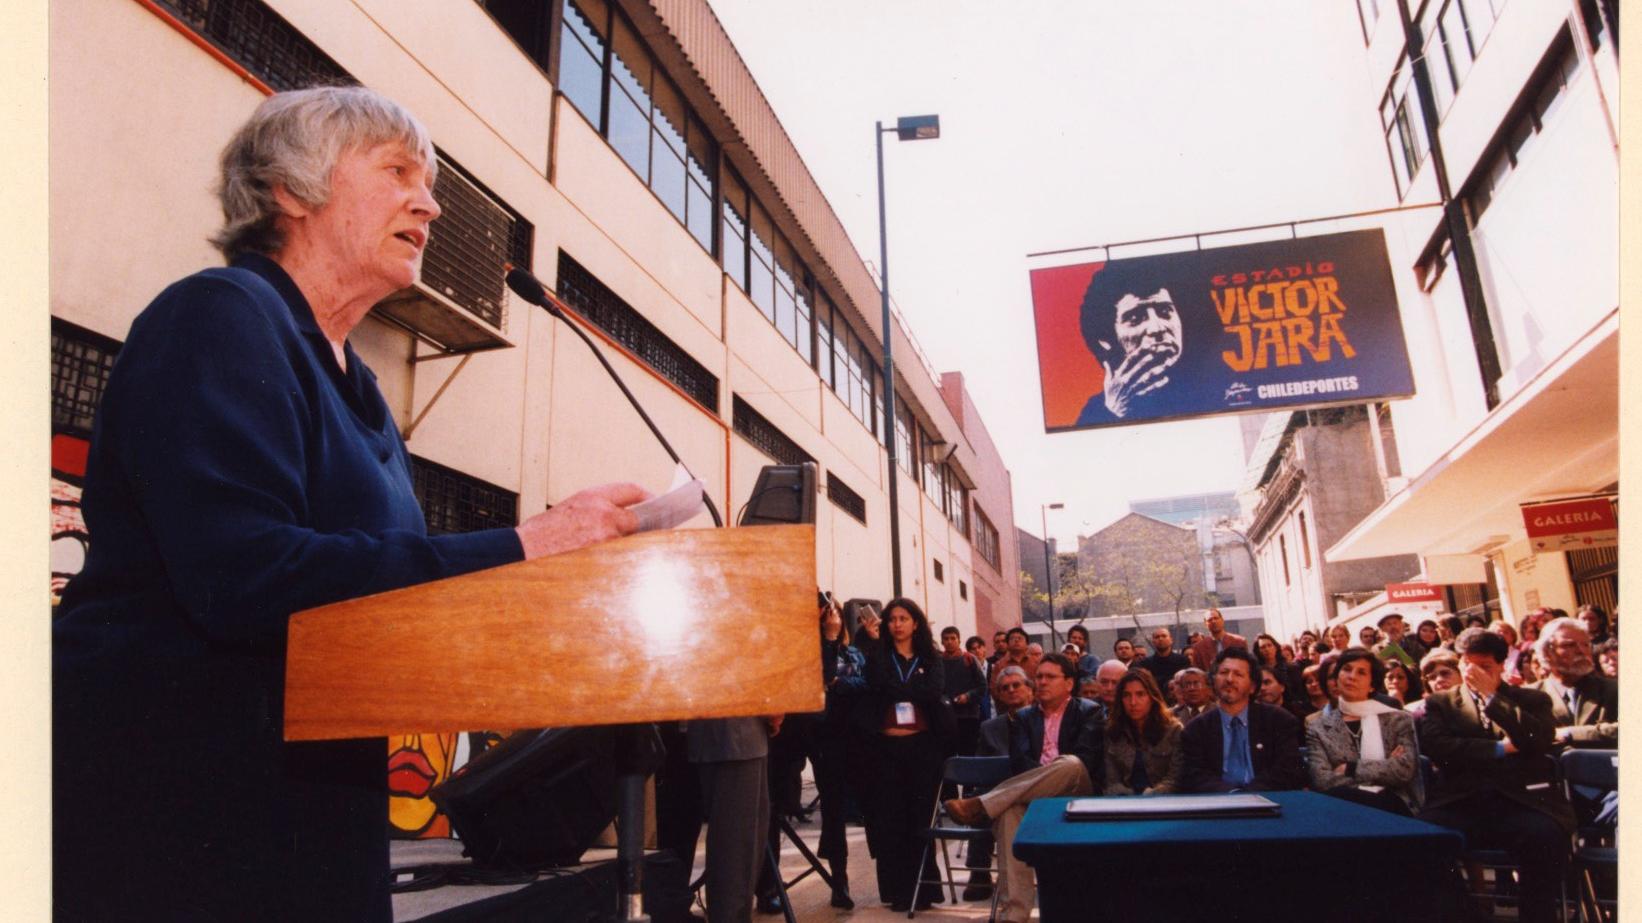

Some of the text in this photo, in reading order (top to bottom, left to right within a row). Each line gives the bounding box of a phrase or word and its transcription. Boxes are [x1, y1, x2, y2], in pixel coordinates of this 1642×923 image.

[1211, 261, 1335, 286] ESTADIO
[1210, 276, 1347, 325] VICTOR
[1222, 312, 1357, 372] JARA
[1257, 376, 1360, 399] CHILEDEPORTES
[1533, 511, 1602, 527] GALERIA
[1392, 588, 1435, 599] GALERIA
